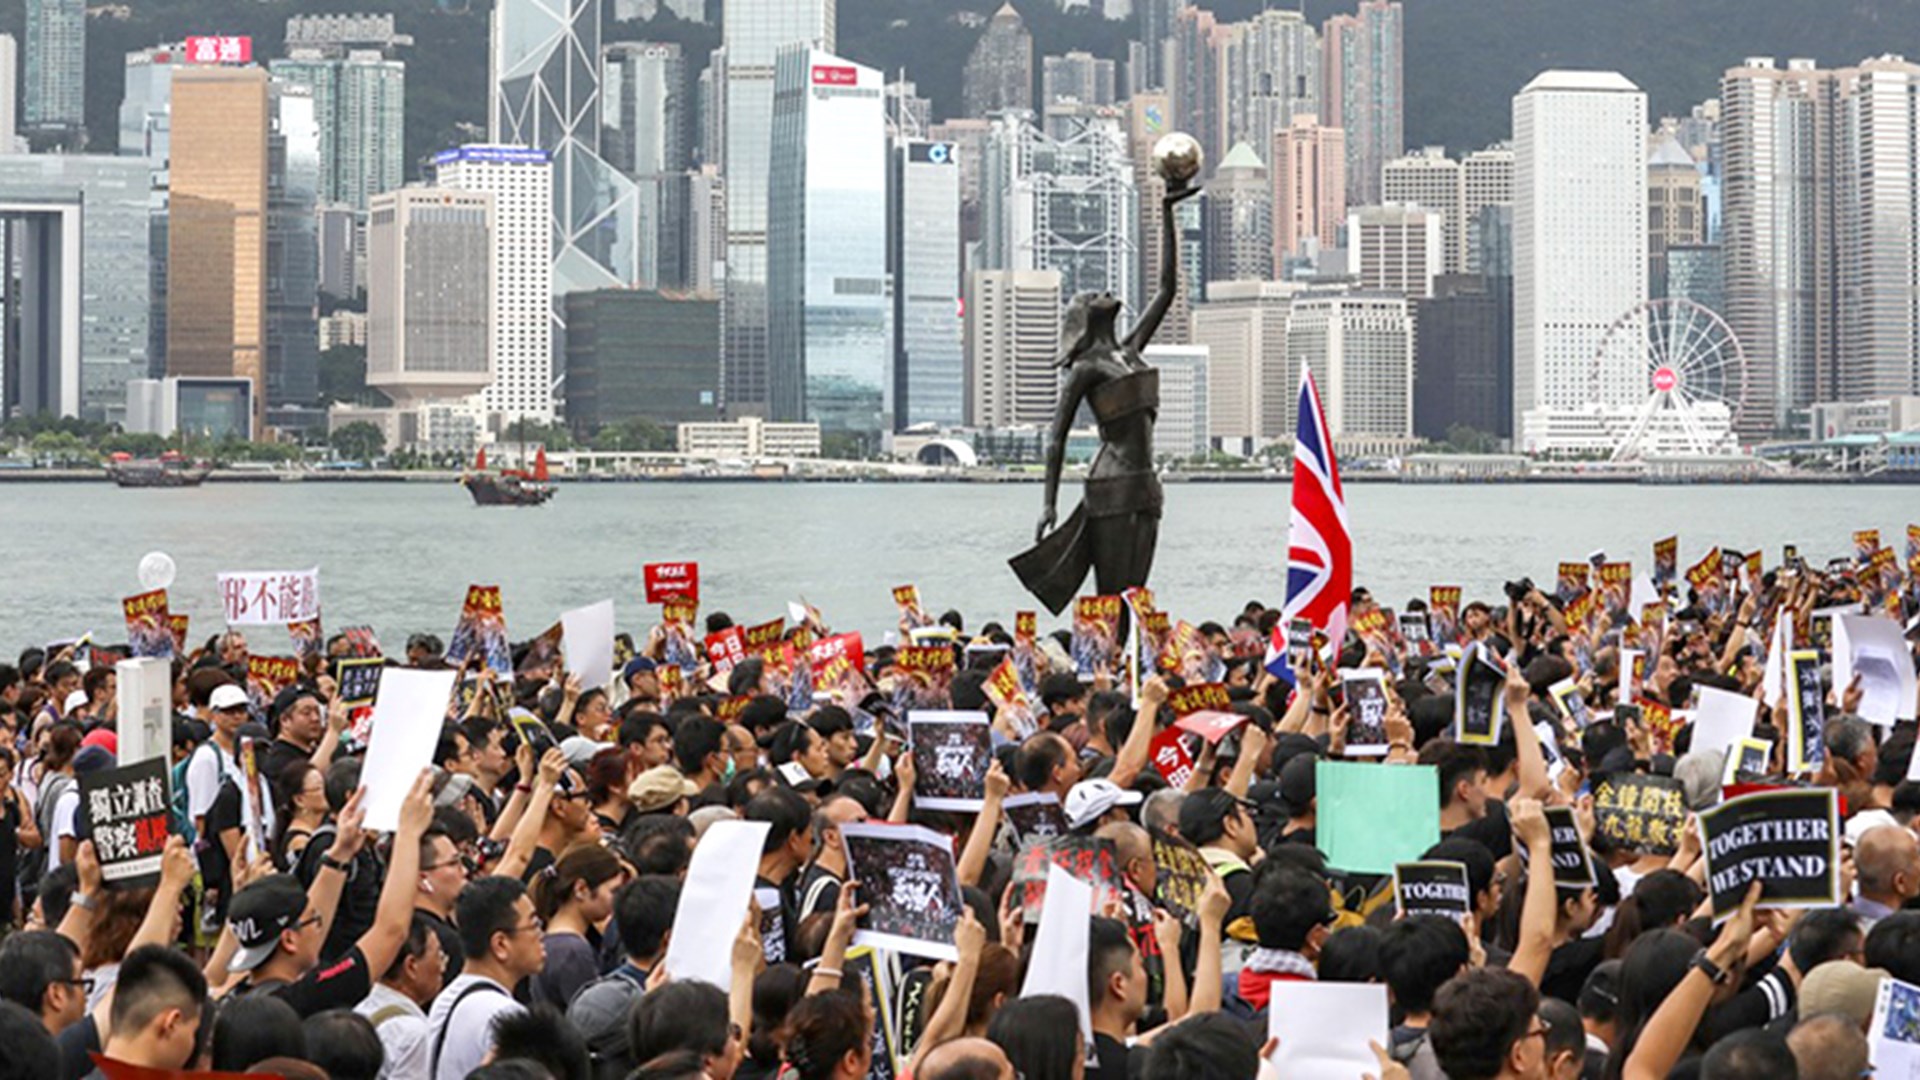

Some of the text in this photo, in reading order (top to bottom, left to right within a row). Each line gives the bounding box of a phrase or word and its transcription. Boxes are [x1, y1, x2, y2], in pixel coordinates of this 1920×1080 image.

[89, 776, 165, 823] 獨立調查
[1709, 819, 1829, 861] TOGETHER
[1712, 854, 1826, 894] WE STAND
